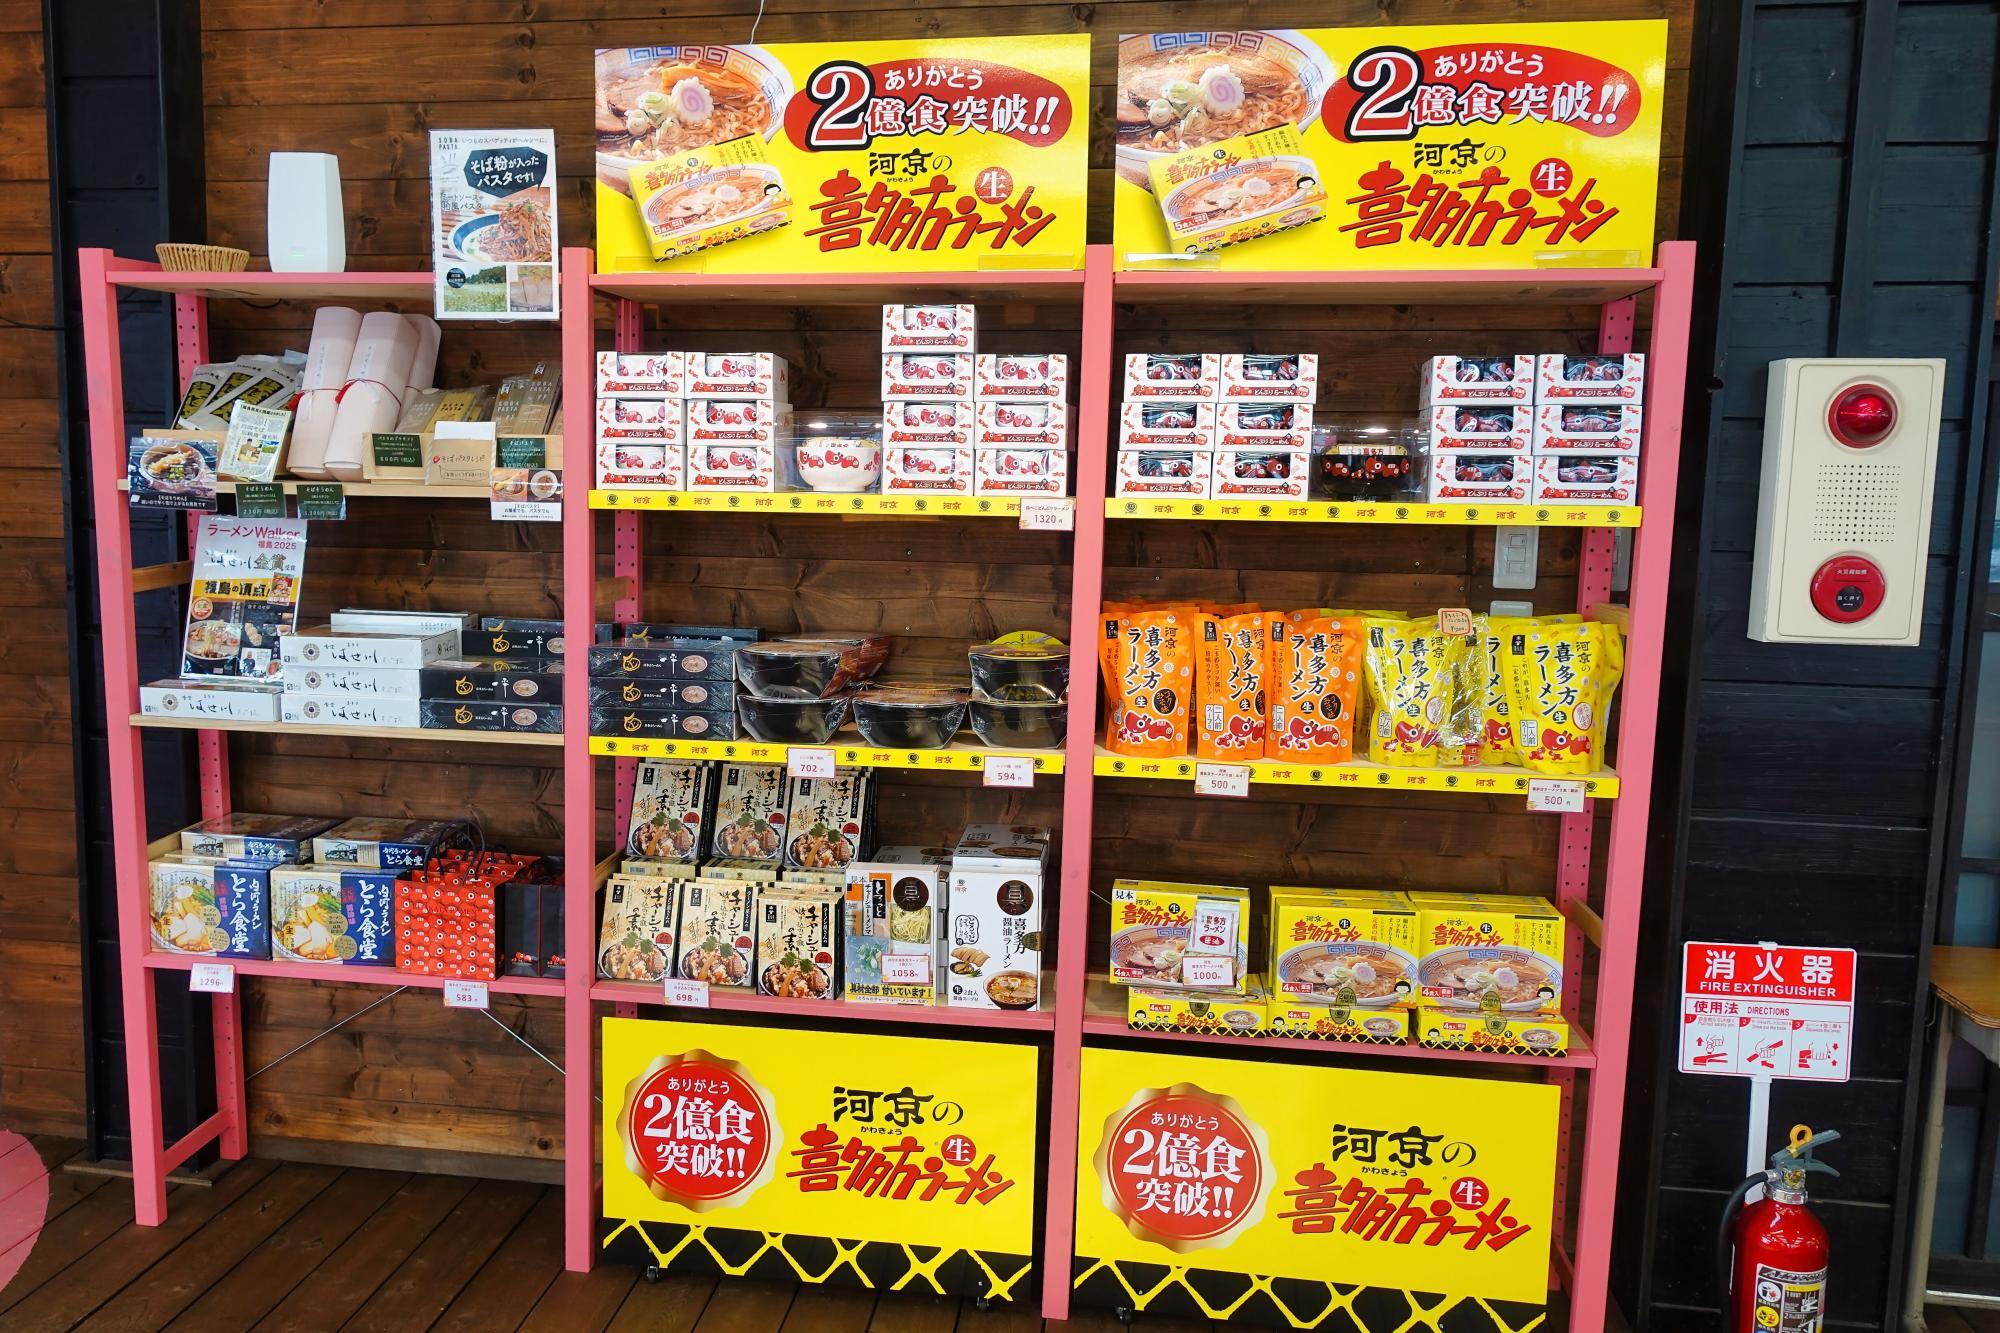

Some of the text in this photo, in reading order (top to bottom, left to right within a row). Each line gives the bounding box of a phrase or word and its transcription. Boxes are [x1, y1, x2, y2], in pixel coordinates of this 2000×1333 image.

[884, 64, 984, 91] ありがとう
[1434, 53, 1544, 78] ありがとう
[470, 155, 540, 175] そば粉が入った
[869, 148, 953, 178] 河京の
[1414, 139, 1505, 168] 河京の
[1432, 167, 1463, 175] かわきょう
[477, 171, 535, 187] パスタです!
[886, 176, 914, 184] かわきょう
[978, 168, 1012, 202] 生
[1535, 162, 1569, 193] 生
[803, 168, 1057, 254] 喜多方ラーメン
[1339, 161, 1621, 249] 喜多方ラーメン
[253, 553, 287, 571] 金賞
[274, 541, 297, 550] 2025
[1124, 628, 1142, 695] ラーメン
[1143, 626, 1163, 690] 喜多方
[1223, 633, 1243, 700] ラーメン
[1237, 629, 1259, 692] 喜多方
[1290, 635, 1307, 701] ラーメン
[1309, 634, 1329, 695] 喜多方
[1392, 639, 1412, 708] ラーメン
[1409, 637, 1431, 700] 喜多方
[1486, 636, 1506, 707] ラーメン
[1553, 641, 1578, 706] 喜多方
[1534, 645, 1558, 716] ラーメン
[1136, 697, 1147, 707] 生
[1240, 699, 1250, 711] 生
[1302, 702, 1313, 713] 生
[1554, 711, 1566, 723] 生
[677, 769, 692, 818] チャーシュー
[761, 769, 778, 818] チャーシュー
[833, 779, 851, 829] チャーシュー
[649, 886, 665, 939] チャーシュー
[1115, 891, 1134, 900] 見本
[230, 873, 251, 954] とら食堂
[357, 879, 379, 960] とら食堂
[727, 889, 743, 943] チャーシュー
[1120, 903, 1193, 927] 喜多方ラーメン
[1204, 924, 1226, 934] ラーメン
[1206, 915, 1226, 926] 喜多方
[1290, 919, 1362, 942] 喜多方ラーメン
[805, 905, 820, 959] チャーシュー
[1002, 917, 1013, 969] 醤油ラーメン
[1014, 918, 1027, 955] 喜多方
[1430, 923, 1504, 947] 喜多方ラーメン
[1704, 949, 1834, 985] 消火器
[850, 983, 932, 999] 具材全部 付いています!
[1700, 981, 1837, 998] FIRE EXTINGUISHER
[1693, 1000, 1740, 1015] 使用法
[1747, 1006, 1790, 1017] DIRECTIONS
[668, 1076, 731, 1095] ありがとう
[643, 1095, 755, 1144] 2億食
[833, 1085, 965, 1128] 河京の
[1151, 1111, 1219, 1131] ありがとう
[860, 1125, 903, 1136] かわきょう
[1331, 1123, 1477, 1167] 河京の
[656, 1142, 746, 1180] 突破!!
[785, 1123, 1016, 1206] 喜多方ラーメン
[944, 1137, 972, 1164] 生
[1122, 1128, 1248, 1184] 2億食
[1361, 1166, 1408, 1178] かわきょう
[1135, 1179, 1234, 1219] 突破!!
[1276, 1162, 1532, 1252] 喜多方ラーメン
[1454, 1179, 1484, 1208] 生
